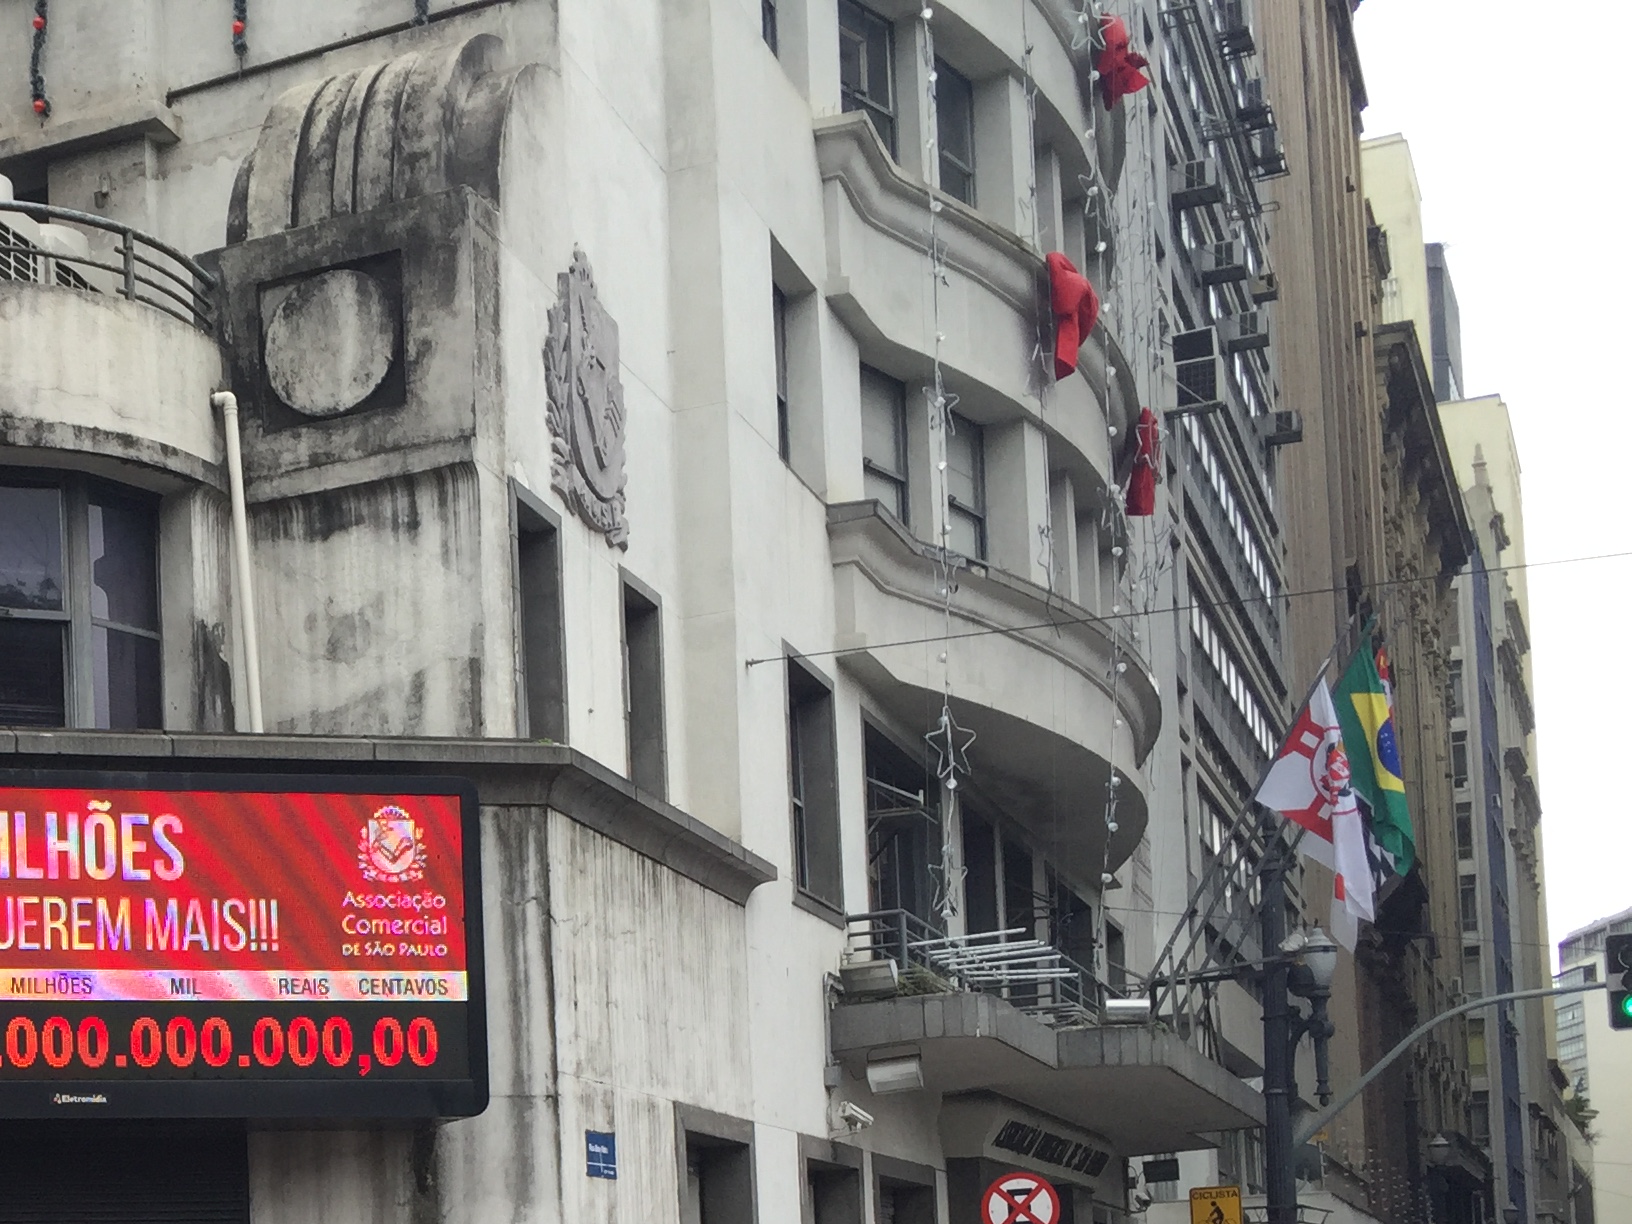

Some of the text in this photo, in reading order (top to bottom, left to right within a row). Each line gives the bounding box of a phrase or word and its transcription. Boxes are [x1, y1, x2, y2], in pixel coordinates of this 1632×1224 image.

[341, 890, 447, 912] Associação
[143, 897, 280, 952] MAIS!!!
[341, 914, 448, 936] Comercial
[341, 940, 448, 957] DE SÃO PAULO
[10, 973, 93, 995] MILHÕES
[169, 977, 203, 996] MIL
[277, 977, 330, 996] REAIS
[357, 977, 449, 997] CENTAVOS
[1193, 1190, 1238, 1200] CICLISTA
